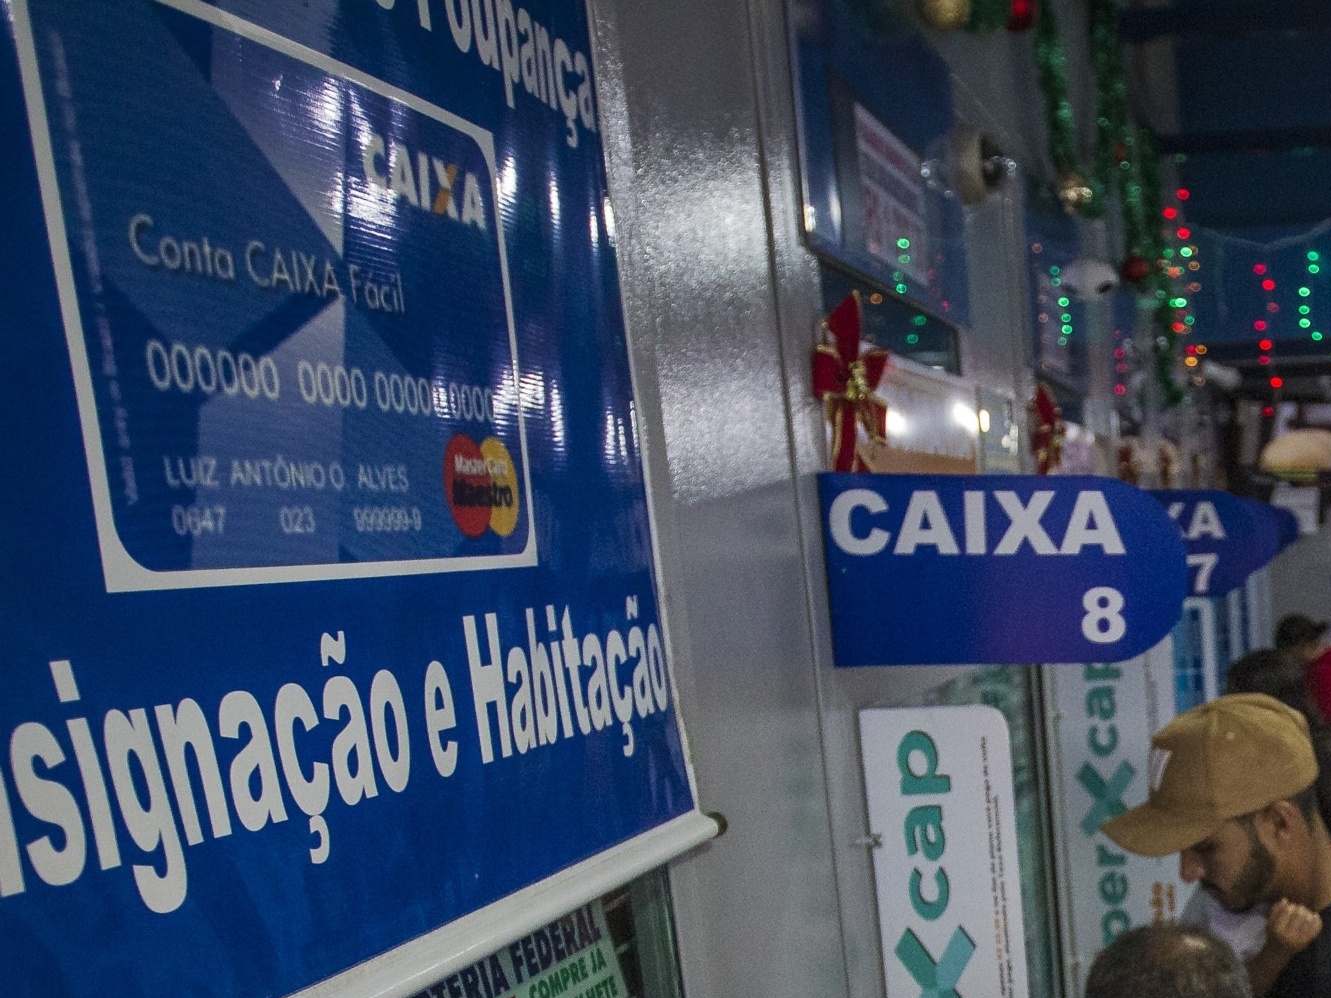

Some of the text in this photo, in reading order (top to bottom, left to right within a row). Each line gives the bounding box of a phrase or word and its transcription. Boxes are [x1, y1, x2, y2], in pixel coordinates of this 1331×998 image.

[363, 132, 486, 228] CAIXA
[128, 213, 404, 313] Conta CAIXA Fácil
[147, 340, 279, 399] 000000
[298, 362, 368, 409] 0000
[164, 455, 219, 487] LUIZ
[358, 463, 409, 490] ALVES
[279, 507, 315, 534] 023
[829, 488, 1127, 556] CAIXA
[1186, 554, 1218, 593] 7
[1081, 586, 1127, 644] 8
[0, 595, 668, 914] signação e Habitação
[507, 902, 602, 984] FEDERAL
